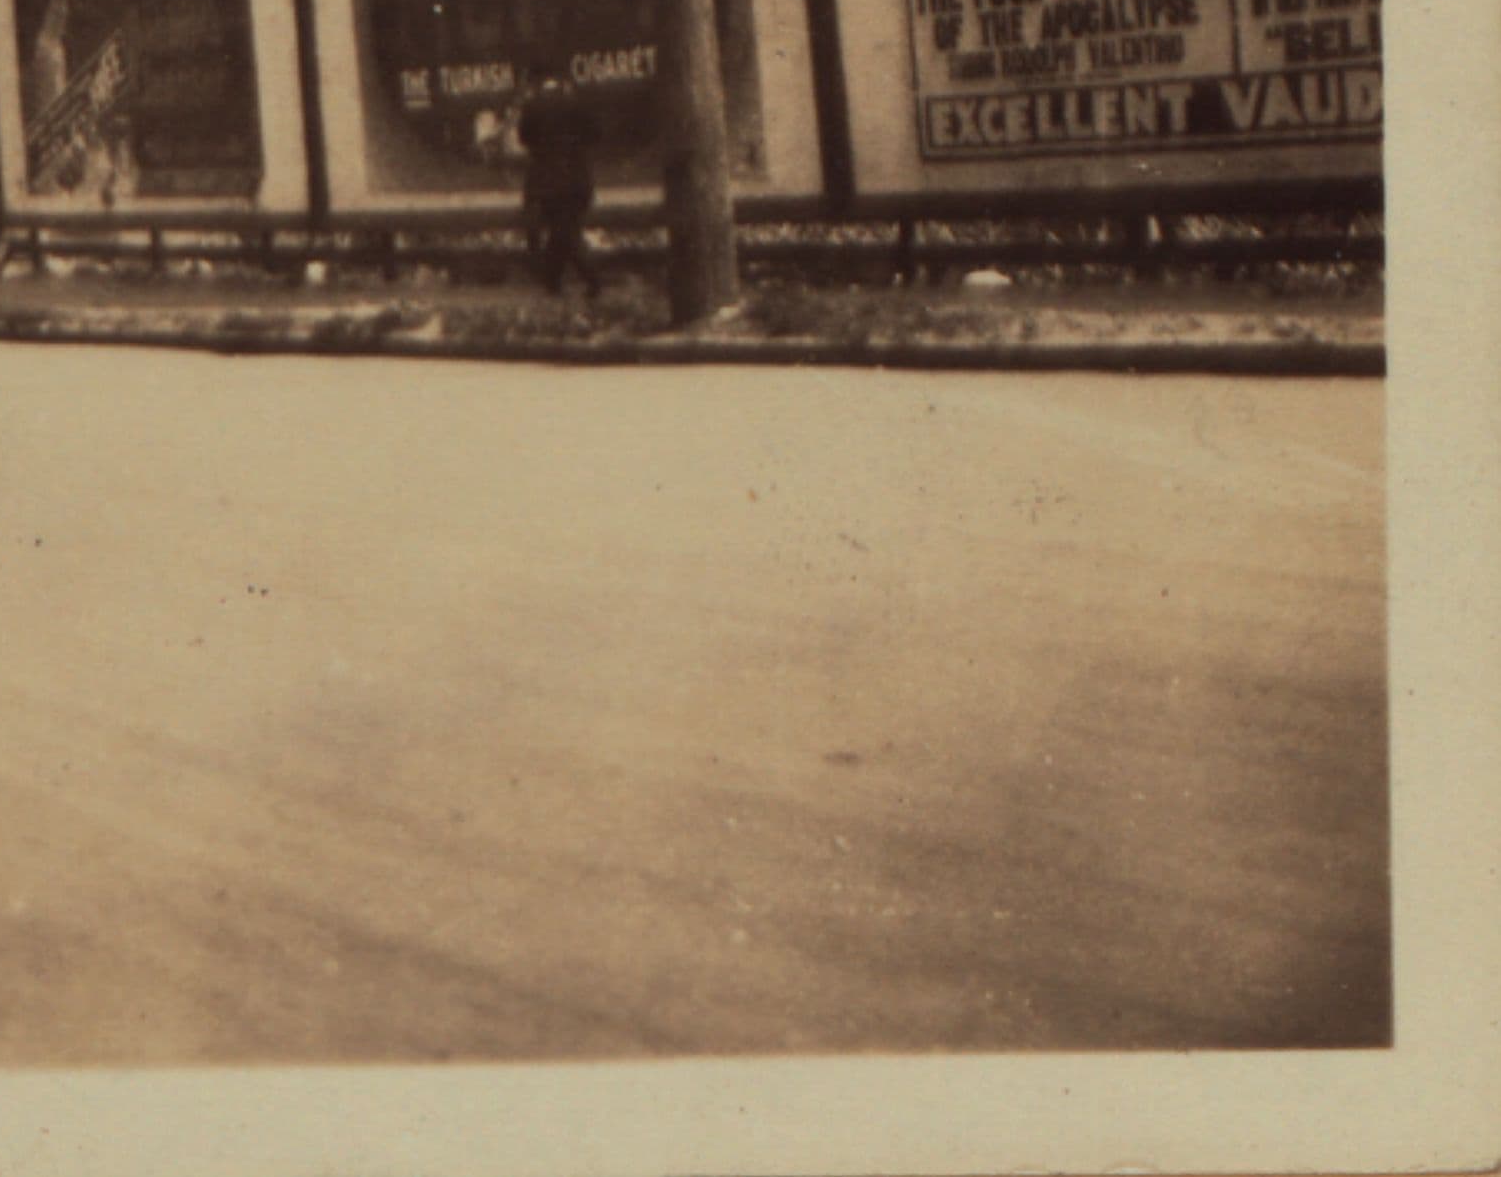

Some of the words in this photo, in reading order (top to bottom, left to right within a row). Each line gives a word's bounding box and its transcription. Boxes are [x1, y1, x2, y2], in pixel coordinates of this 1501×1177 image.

[977, 7, 1024, 48] THE
[441, 61, 514, 96] TURKISH
[929, 82, 1194, 148] EXCELLENT
